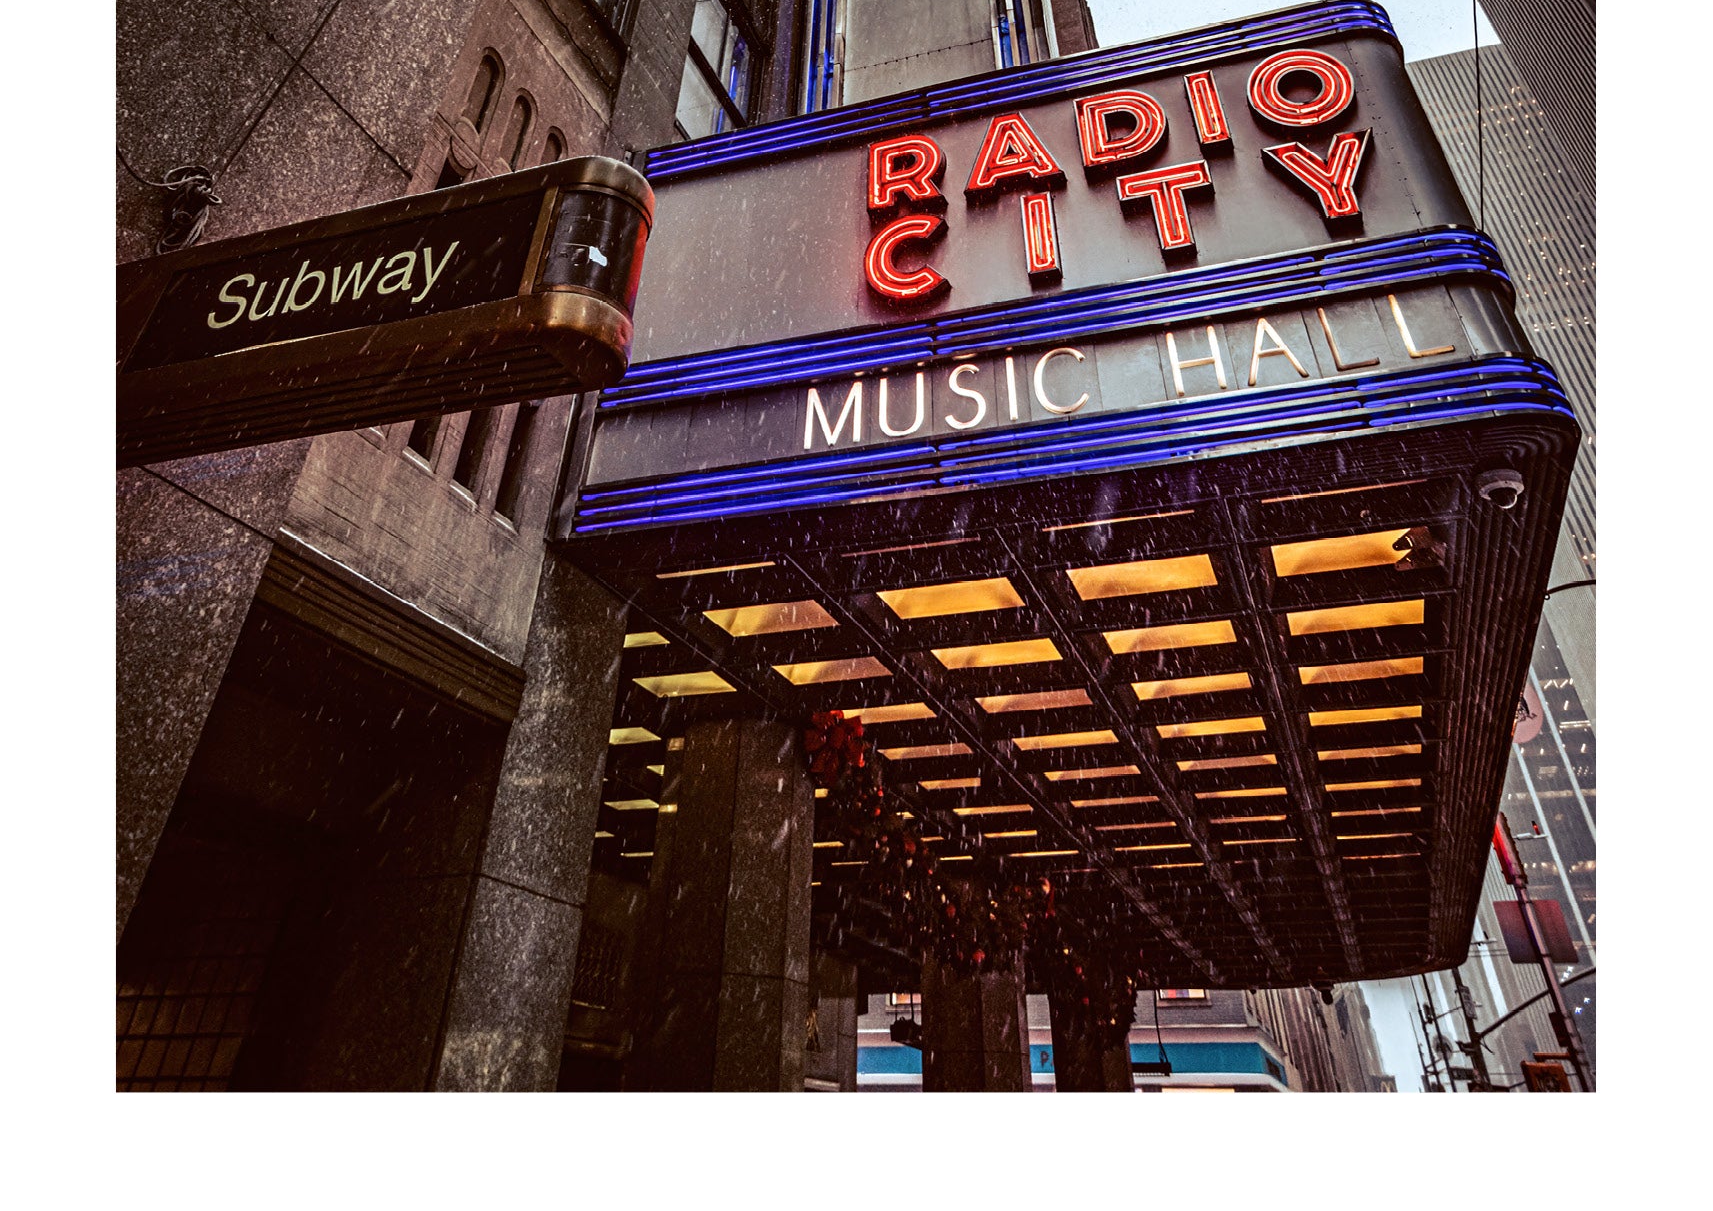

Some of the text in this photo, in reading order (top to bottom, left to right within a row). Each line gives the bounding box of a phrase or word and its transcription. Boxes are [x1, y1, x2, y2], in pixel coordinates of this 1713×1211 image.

[866, 48, 1355, 213] RADIO
[207, 240, 461, 331] Subway
[864, 127, 1374, 299] CITY
[802, 293, 1456, 451] MUSIC HALL
